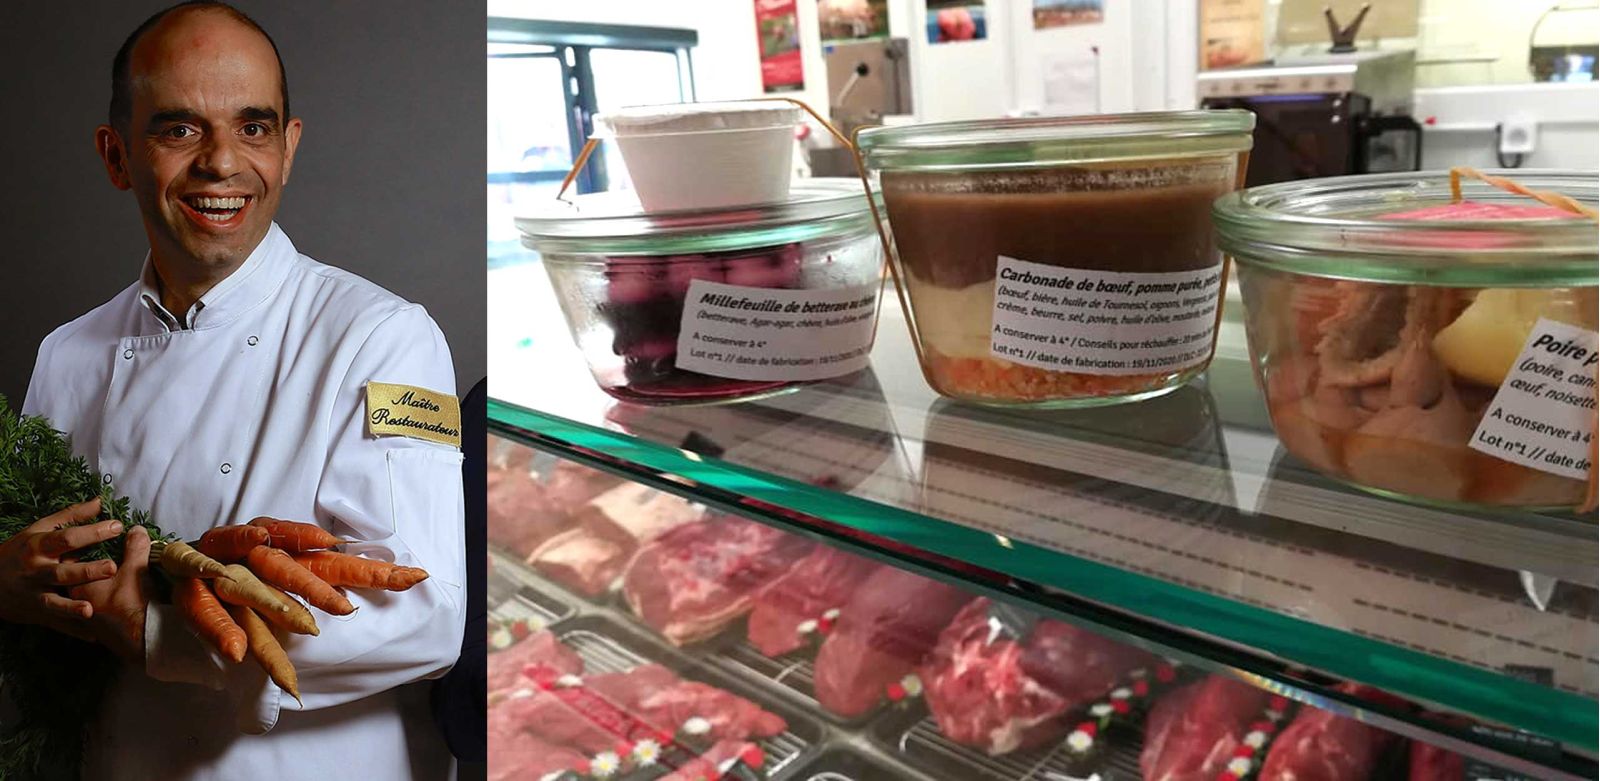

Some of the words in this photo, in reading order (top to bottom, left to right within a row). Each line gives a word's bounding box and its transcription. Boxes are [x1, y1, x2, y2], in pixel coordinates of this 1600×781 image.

[1000, 267, 1074, 290] Carbonade
[1076, 278, 1095, 291] de
[1095, 280, 1135, 296] bœuf,
[1134, 283, 1178, 296] pomme
[1176, 276, 1202, 295] purée,
[700, 292, 783, 312] Millefeuille
[783, 300, 801, 313] de
[801, 301, 849, 313] betterave
[1031, 291, 1059, 306] bière,
[1060, 296, 1088, 308] huile
[1088, 299, 1102, 309] de
[996, 301, 1029, 316] crème,
[1030, 306, 1065, 321] beurre,
[1068, 312, 1085, 323] sel,
[1085, 314, 1119, 325] poivre,
[1120, 314, 1144, 324] huile
[692, 331, 700, 341] A
[701, 334, 748, 348] conserver
[748, 340, 756, 348] à
[994, 323, 1001, 333] A
[1002, 327, 1049, 344] conserver
[1050, 335, 1057, 344] à
[1058, 336, 1070, 345] 4°
[1070, 336, 1078, 348] /
[1078, 337, 1118, 350] Conseils
[1119, 341, 1140, 351] pour
[1532, 333, 1588, 361] Poire
[690, 348, 706, 359] Lot
[993, 342, 1008, 355] Lot
[1008, 345, 1023, 359] n°1
[1026, 350, 1037, 361] //
[1037, 352, 1060, 364] date
[1060, 355, 1074, 366] de
[1074, 356, 1126, 369] fabrication
[1518, 356, 1564, 381] (poire,
[1509, 378, 1543, 398] œuf,
[391, 390, 440, 412] Maître
[371, 408, 460, 437] Restaurateur
[1490, 406, 1503, 420] A
[1504, 412, 1572, 441] conserver
[1571, 429, 1582, 442] à
[1478, 429, 1503, 448] Lot
[1503, 439, 1527, 456] n°1
[1527, 447, 1546, 460] //
[1544, 450, 1575, 468] date
[1574, 457, 1592, 471] de
